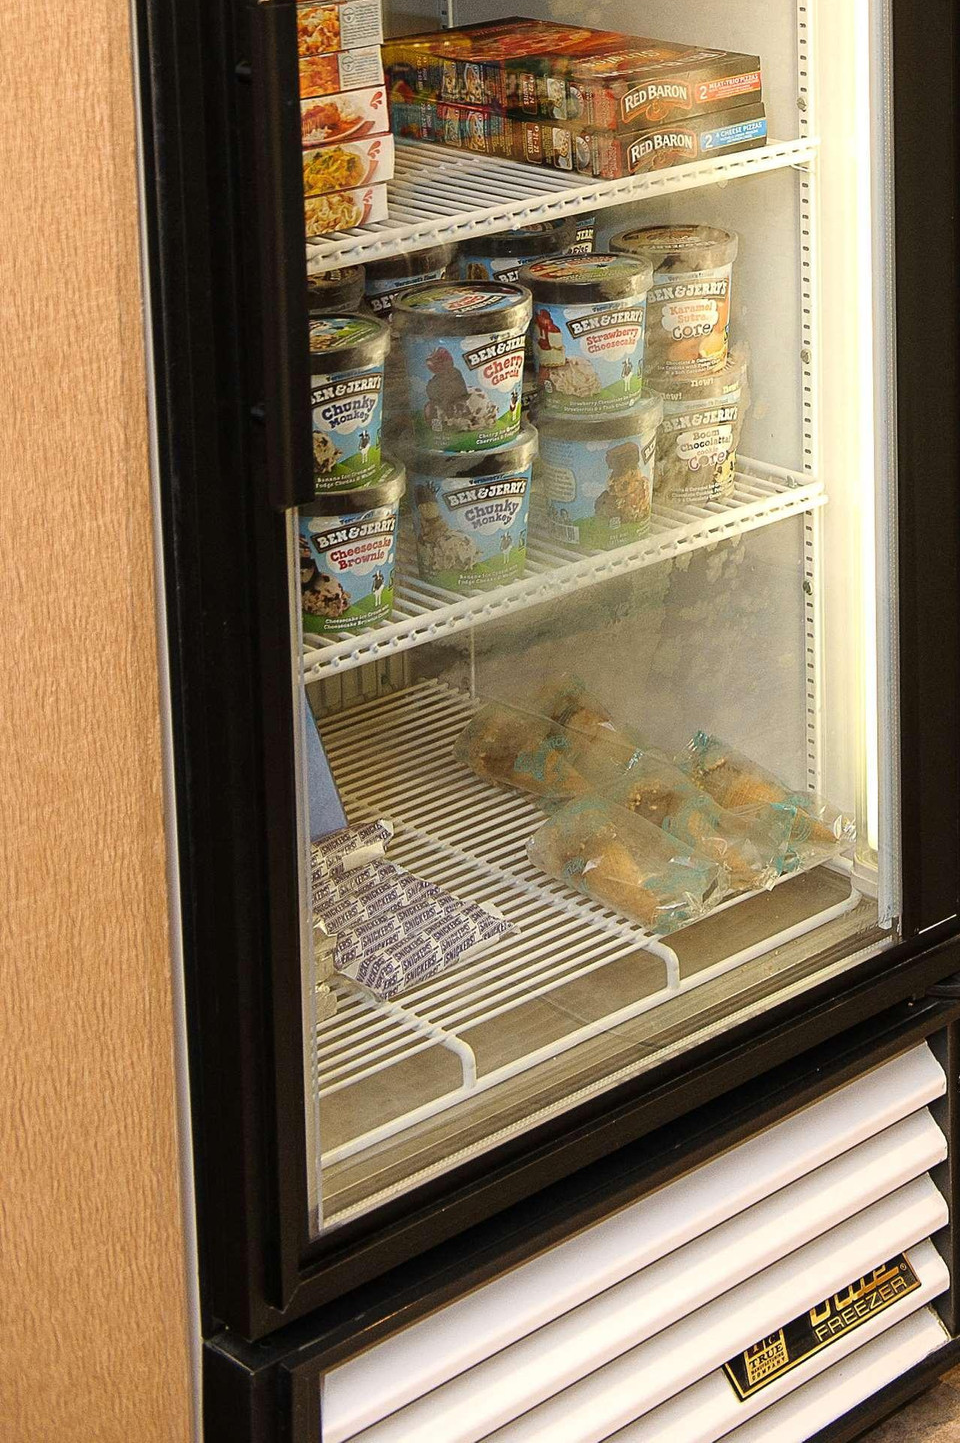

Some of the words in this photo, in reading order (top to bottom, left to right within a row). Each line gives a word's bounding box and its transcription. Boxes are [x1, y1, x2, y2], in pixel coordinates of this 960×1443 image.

[624, 89, 646, 113] RED
[648, 84, 687, 100] BARON
[700, 86, 708, 99] 2
[705, 134, 713, 148] 2
[721, 127, 742, 137] CHEESE
[743, 122, 762, 131] PIZZAS
[631, 140, 654, 163] RED
[654, 134, 693, 149] BARON
[670, 303, 712, 315] Karamel
[678, 314, 706, 323] Sutra
[586, 328, 638, 346] Strawberry
[483, 355, 523, 379] Cherry
[492, 369, 519, 385] Garcia
[322, 395, 376, 421] Chunky
[329, 409, 369, 429] Monkey
[693, 429, 720, 440] Boom
[465, 499, 520, 521] Chunky
[472, 513, 512, 529] Monkey
[330, 537, 391, 562] Cheesecake
[338, 549, 385, 570] Brownie
[360, 882, 389, 905] SNICKERS
[326, 904, 358, 931] SNICKERS
[354, 915, 388, 937] SNICKERS
[402, 908, 436, 934] SNICKERS
[360, 922, 394, 949] SNICKERS
[401, 942, 432, 972] SNICKERS
[404, 953, 437, 982] SNICKERS
[814, 1275, 908, 1341] FREEZER
[750, 1342, 783, 1368] TRUE
[752, 1357, 787, 1381] COMPANY
